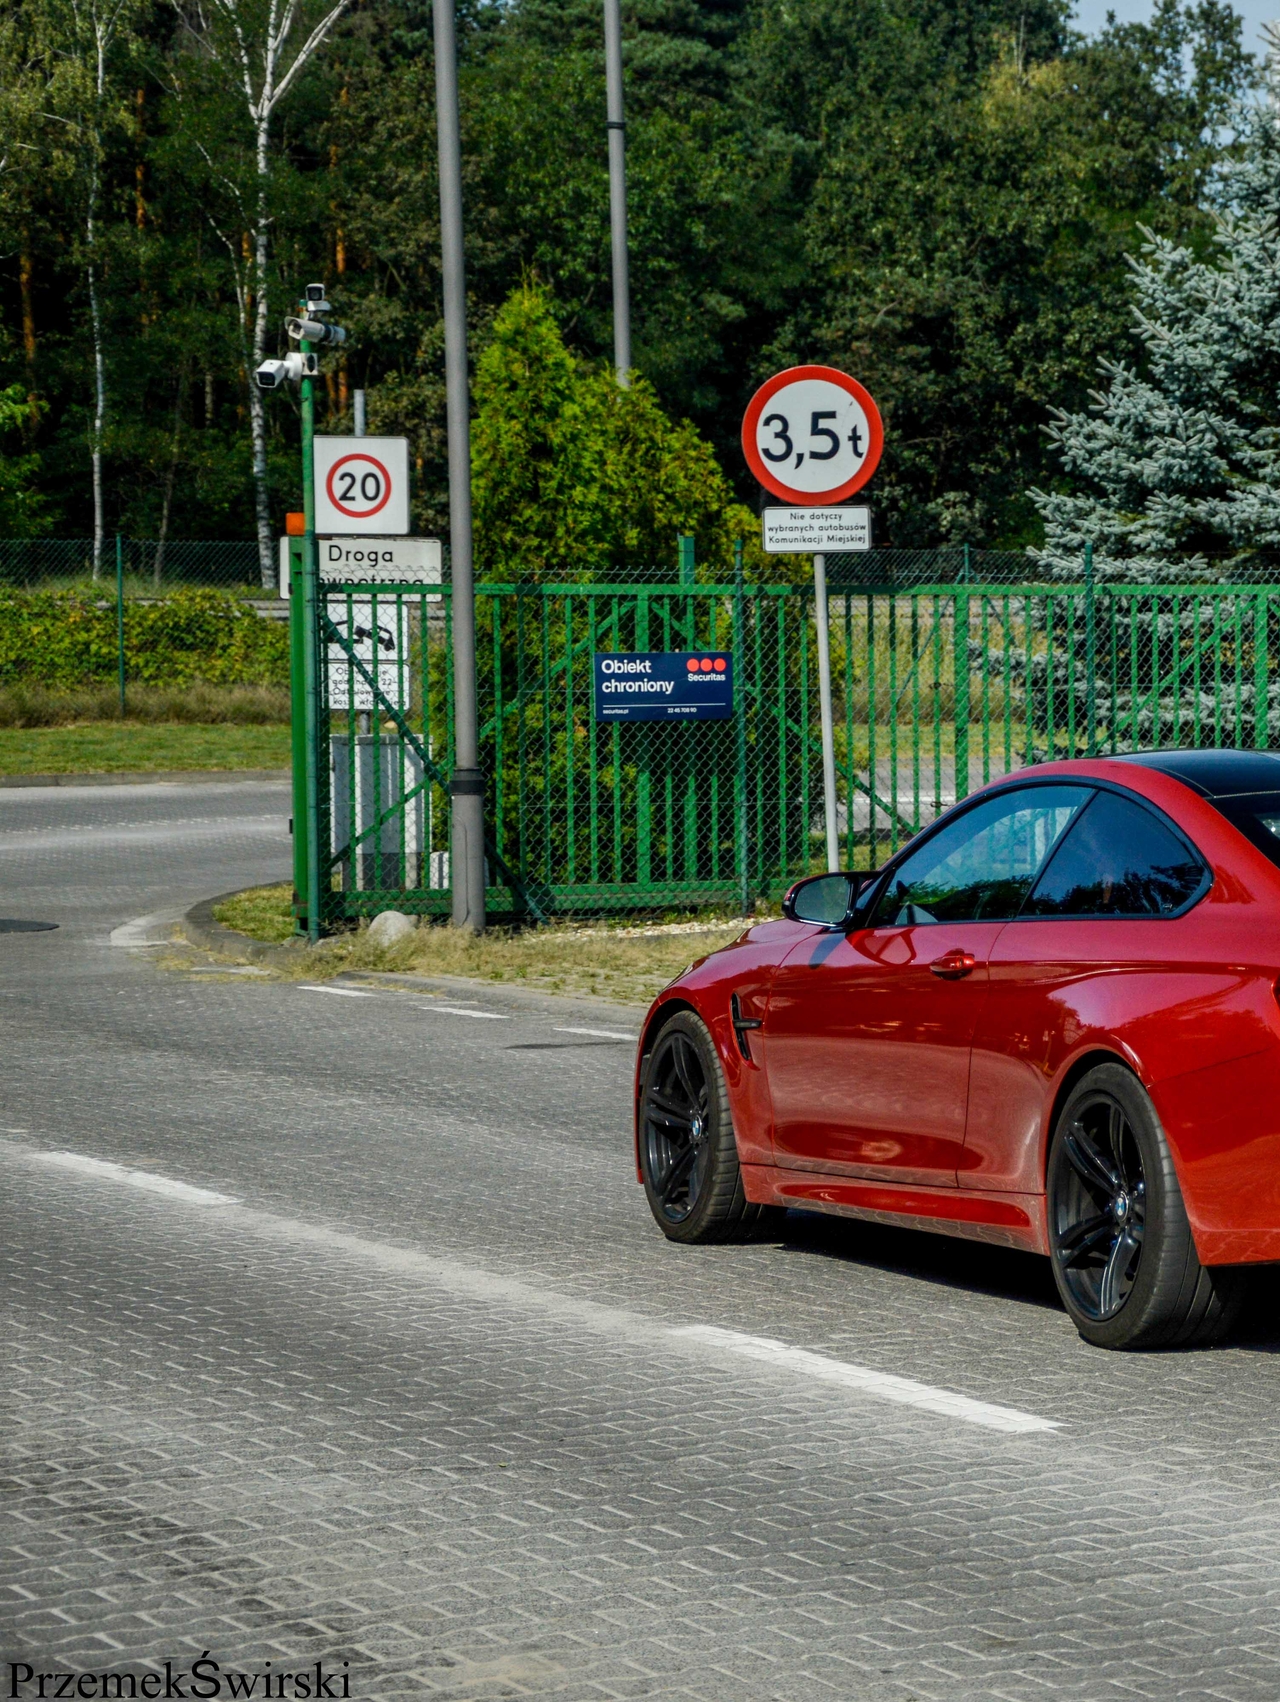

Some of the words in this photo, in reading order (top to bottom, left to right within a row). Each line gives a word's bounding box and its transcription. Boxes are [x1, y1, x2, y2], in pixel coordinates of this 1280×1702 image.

[761, 411, 864, 469] 3,5t
[338, 472, 381, 501] 20
[790, 512, 805, 521] Nie
[809, 512, 843, 522] dotyczy
[767, 524, 815, 534] wybranych
[818, 523, 866, 532] autobusów
[769, 535, 823, 545] Komunikacji
[827, 534, 866, 544] Miejskiej
[328, 545, 394, 568] Droga
[601, 659, 652, 674] Obiekt
[687, 673, 726, 682] Securitas
[602, 678, 675, 695] chroniony
